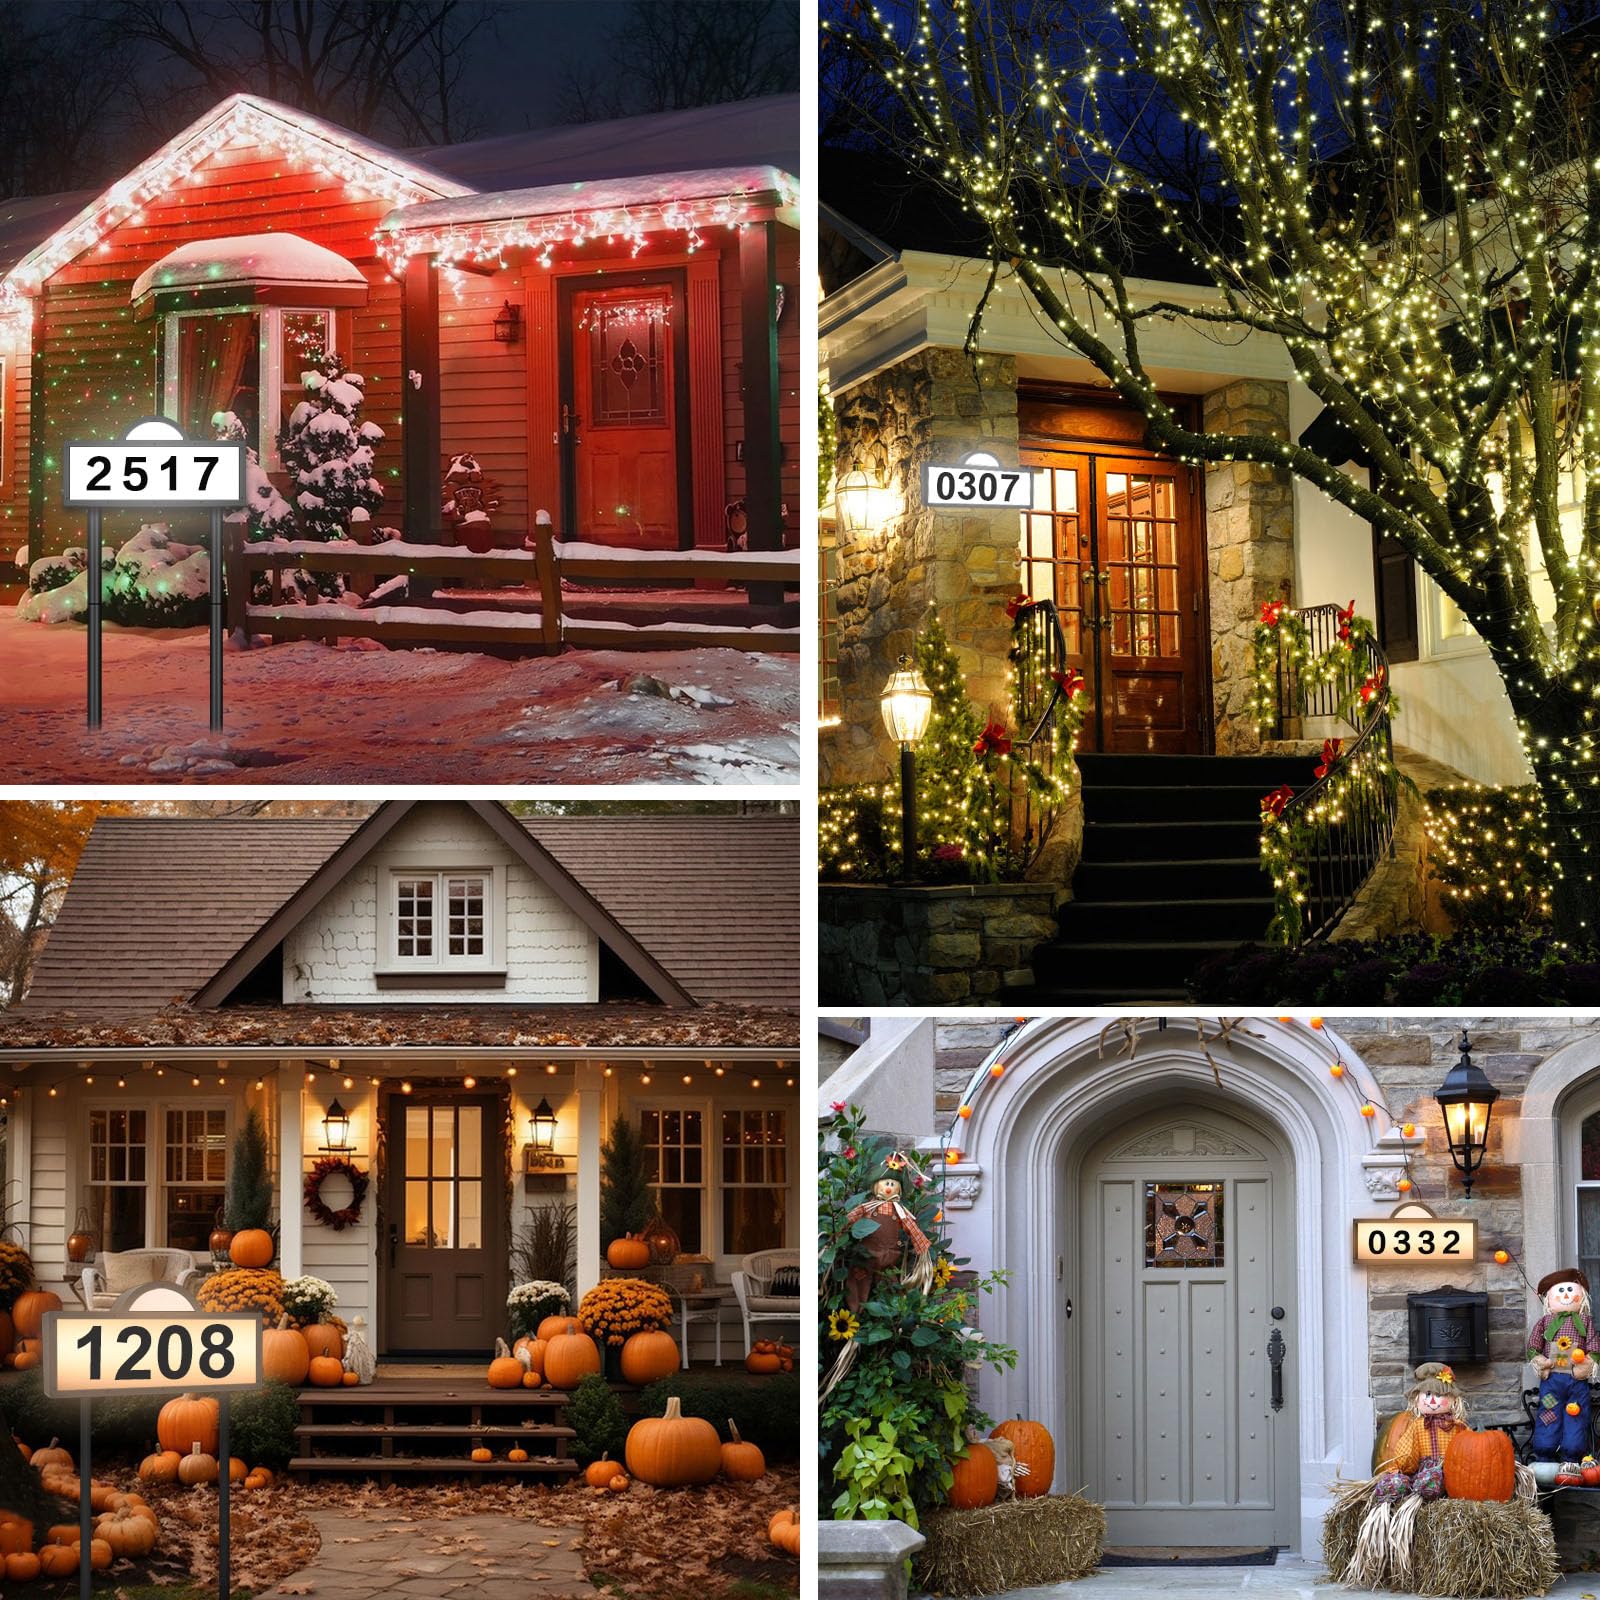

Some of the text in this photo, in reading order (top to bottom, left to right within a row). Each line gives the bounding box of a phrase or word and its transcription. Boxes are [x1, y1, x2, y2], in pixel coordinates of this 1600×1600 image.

[87, 456, 219, 492] 2517
[936, 471, 1020, 502] 0307
[1368, 1230, 1460, 1255] 0332
[77, 1324, 235, 1380] 1208
